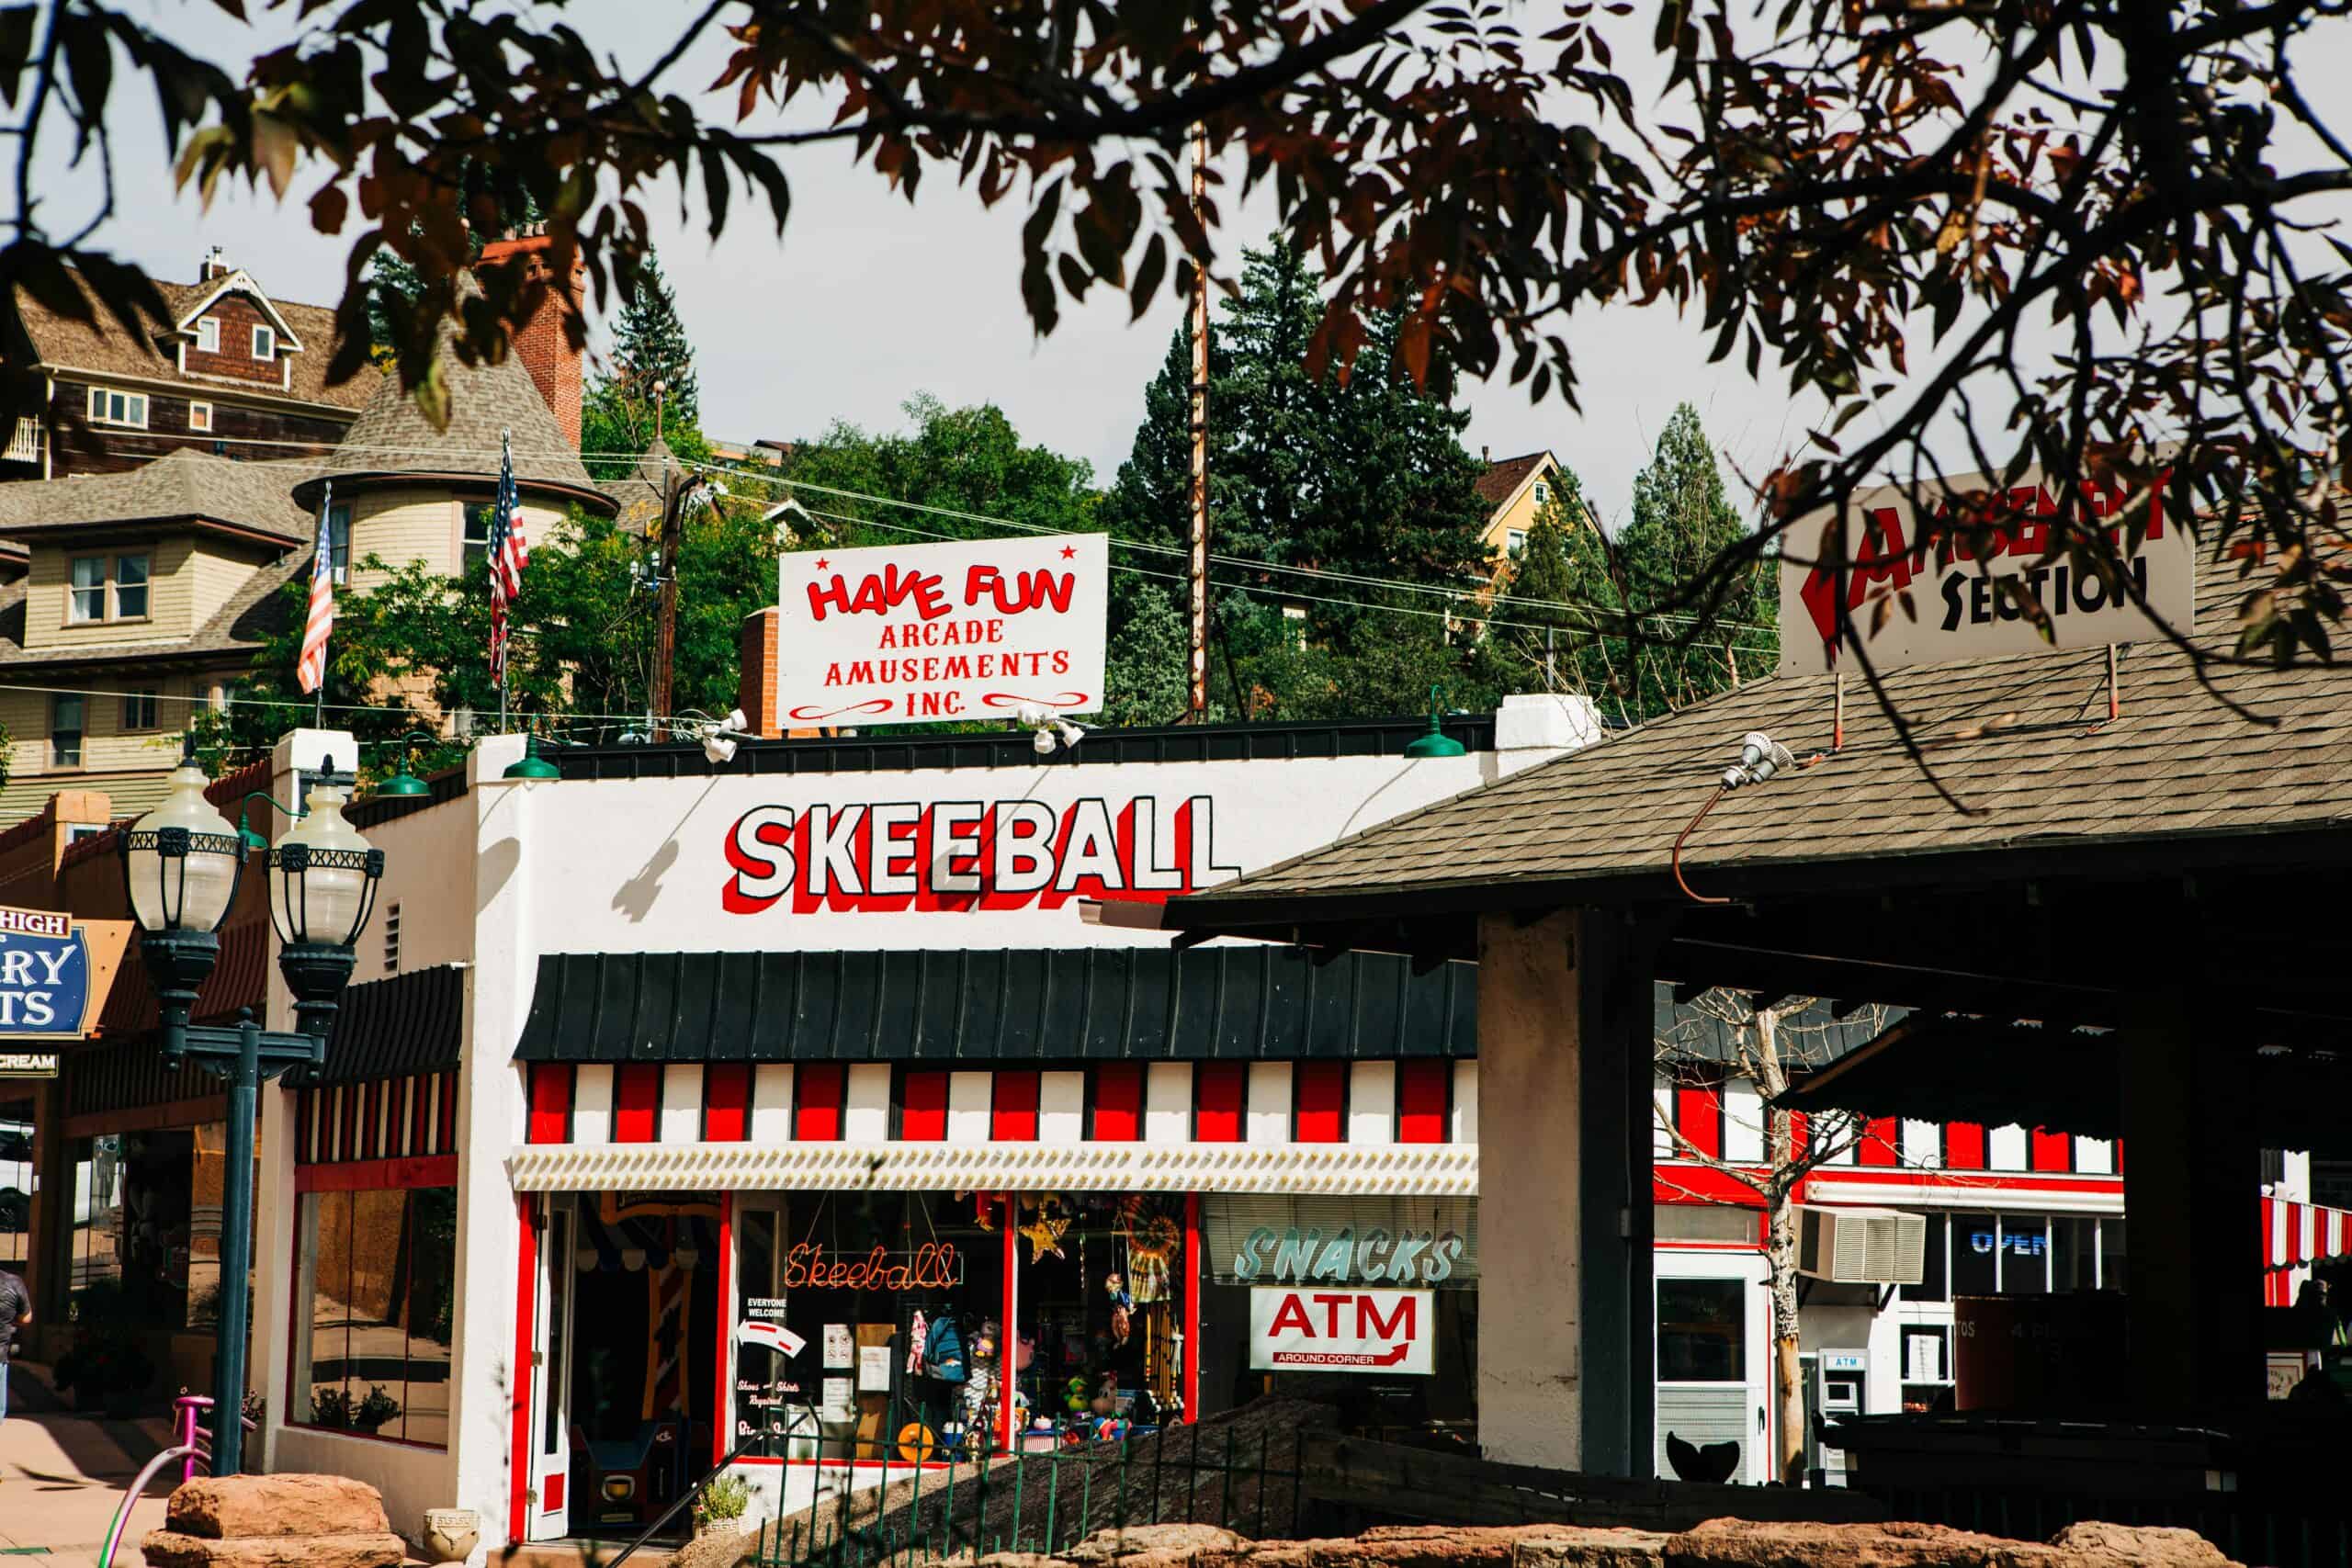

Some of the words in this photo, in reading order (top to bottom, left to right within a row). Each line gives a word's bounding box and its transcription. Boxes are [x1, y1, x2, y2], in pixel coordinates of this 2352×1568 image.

[808, 563, 952, 621] HAVE
[964, 564, 1075, 615] FUN
[1940, 557, 2146, 631] SECTION
[878, 619, 1003, 649] ARCADE
[823, 649, 1069, 686] AMUSEMENTS
[906, 691, 966, 716] INC.
[723, 795, 1242, 914] SKEEBALL
[0, 910, 63, 934] HIGH
[0, 944, 77, 987] RY
[785, 1242, 959, 1291] Skeeball
[1234, 1226, 1463, 1280] SNACKS
[748, 1298, 786, 1307] EVERYONE
[749, 1308, 785, 1317] WELCOME
[1268, 1293, 1416, 1340] ATM
[1278, 1353, 1327, 1364] AROUND
[1328, 1354, 1374, 1365] CORNER
[1836, 1358, 1858, 1367] ATM
